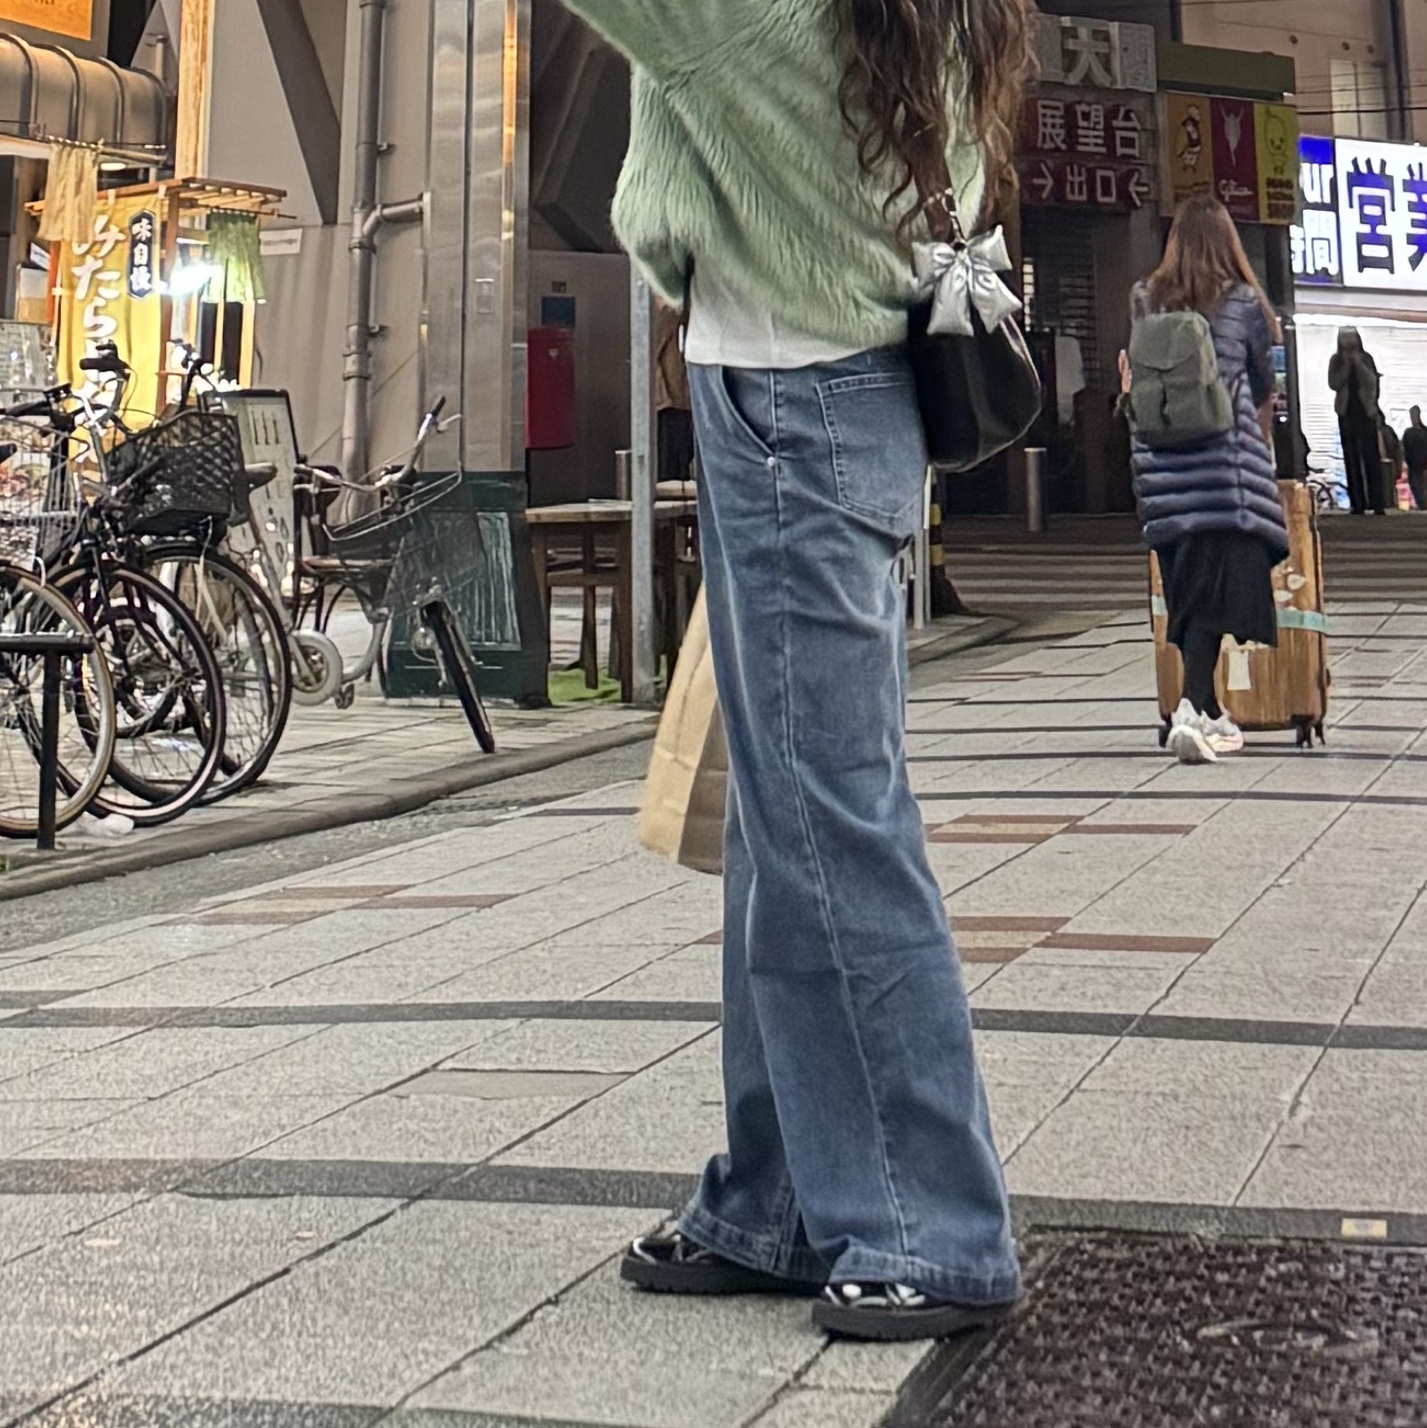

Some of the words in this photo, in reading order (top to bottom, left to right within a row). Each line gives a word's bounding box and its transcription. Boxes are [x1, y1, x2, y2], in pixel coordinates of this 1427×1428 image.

[1036, 99, 1143, 158] 展望台
[1065, 163, 1117, 204] 出口
[1298, 162, 1334, 204] ur
[129, 217, 153, 292] 味自慢
